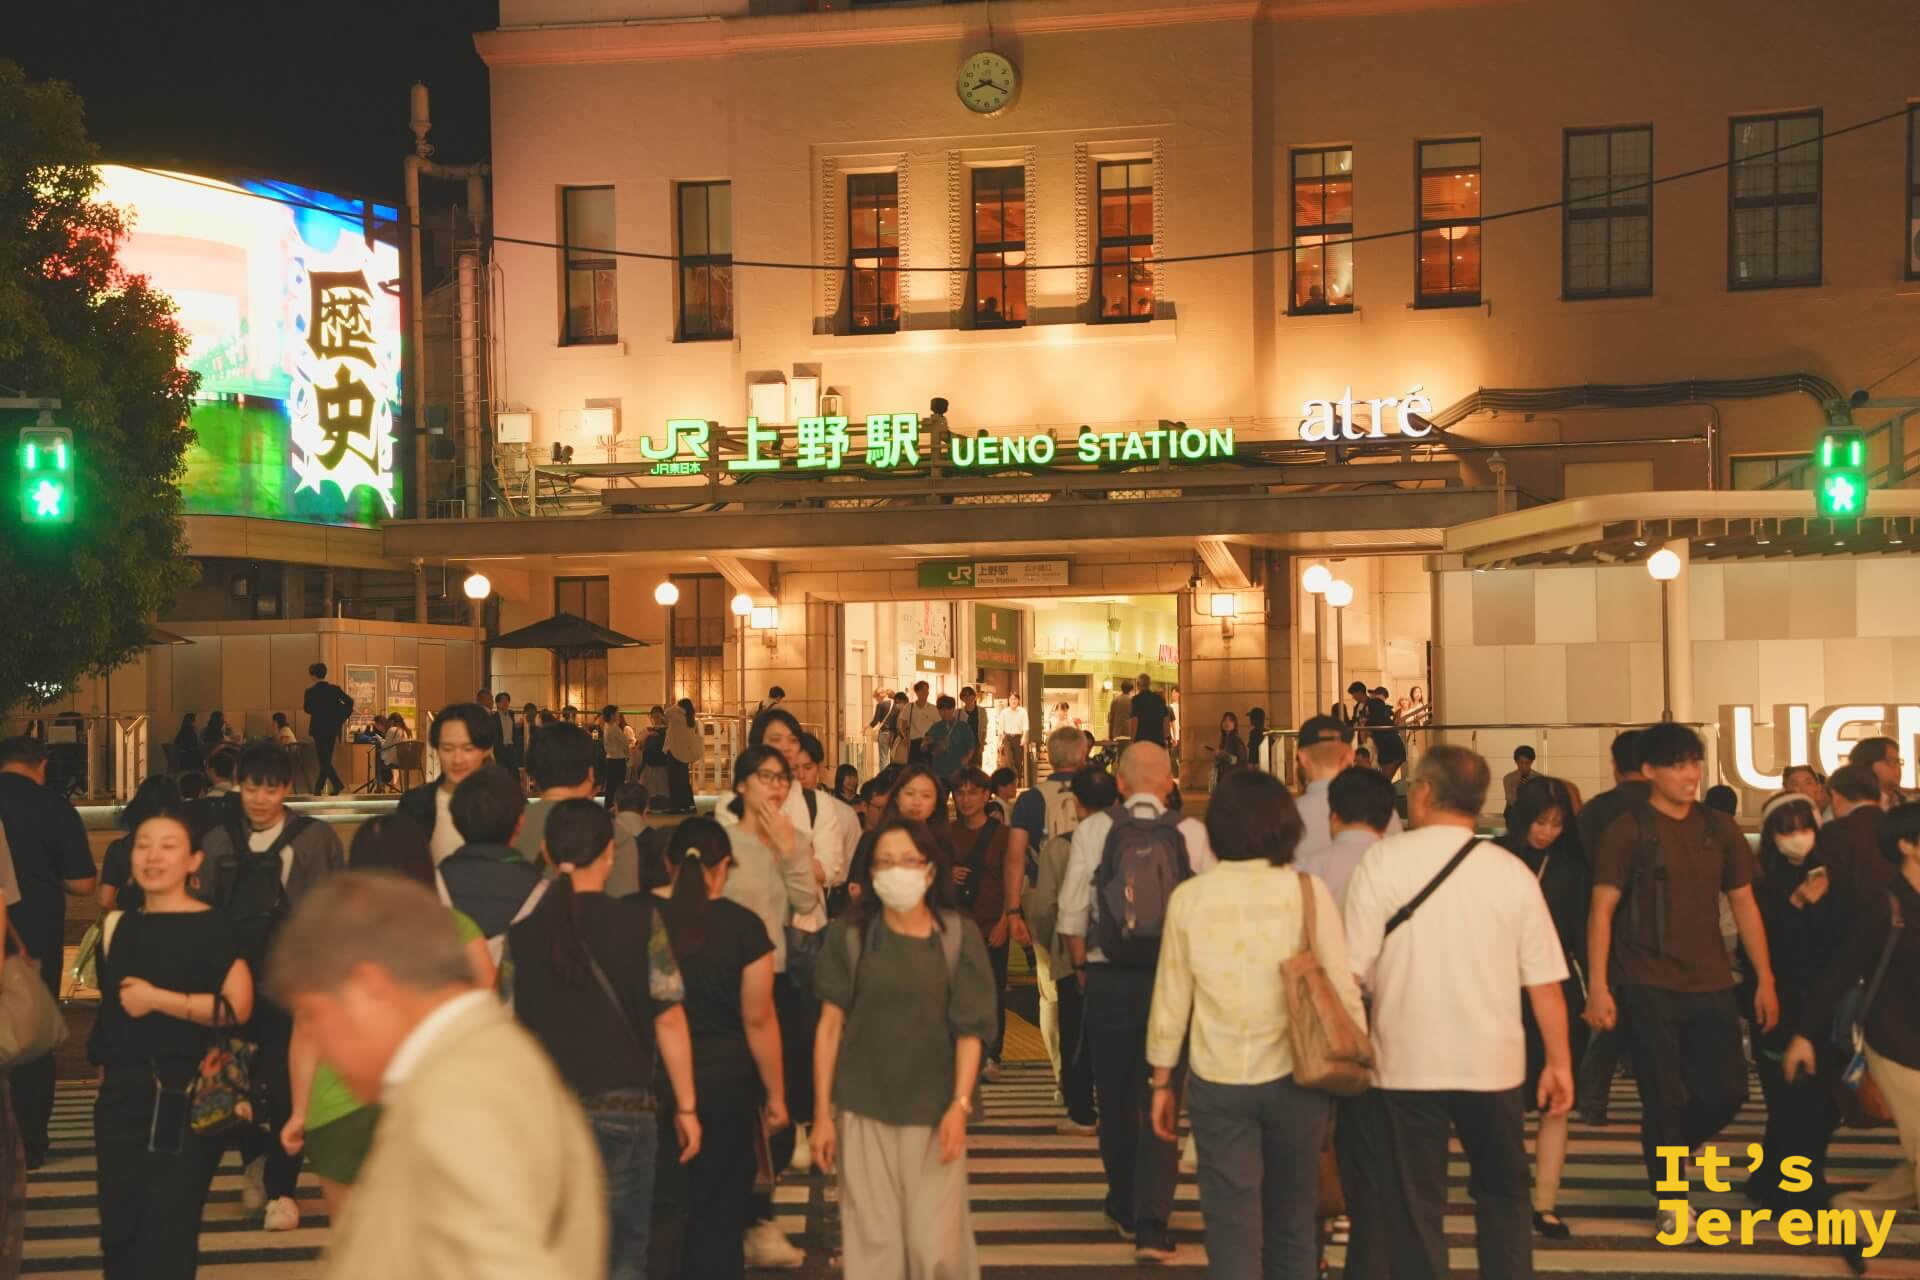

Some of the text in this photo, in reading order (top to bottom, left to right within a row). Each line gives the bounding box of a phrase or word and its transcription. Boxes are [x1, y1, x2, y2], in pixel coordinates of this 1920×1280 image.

[307, 269, 380, 476] 歴史
[1299, 384, 1433, 442] atré
[640, 419, 710, 460] JR
[728, 413, 920, 470] 上野駅
[951, 428, 1234, 466] UENO STATION
[650, 462, 701, 474] JR東日本
[948, 566, 973, 580] JR
